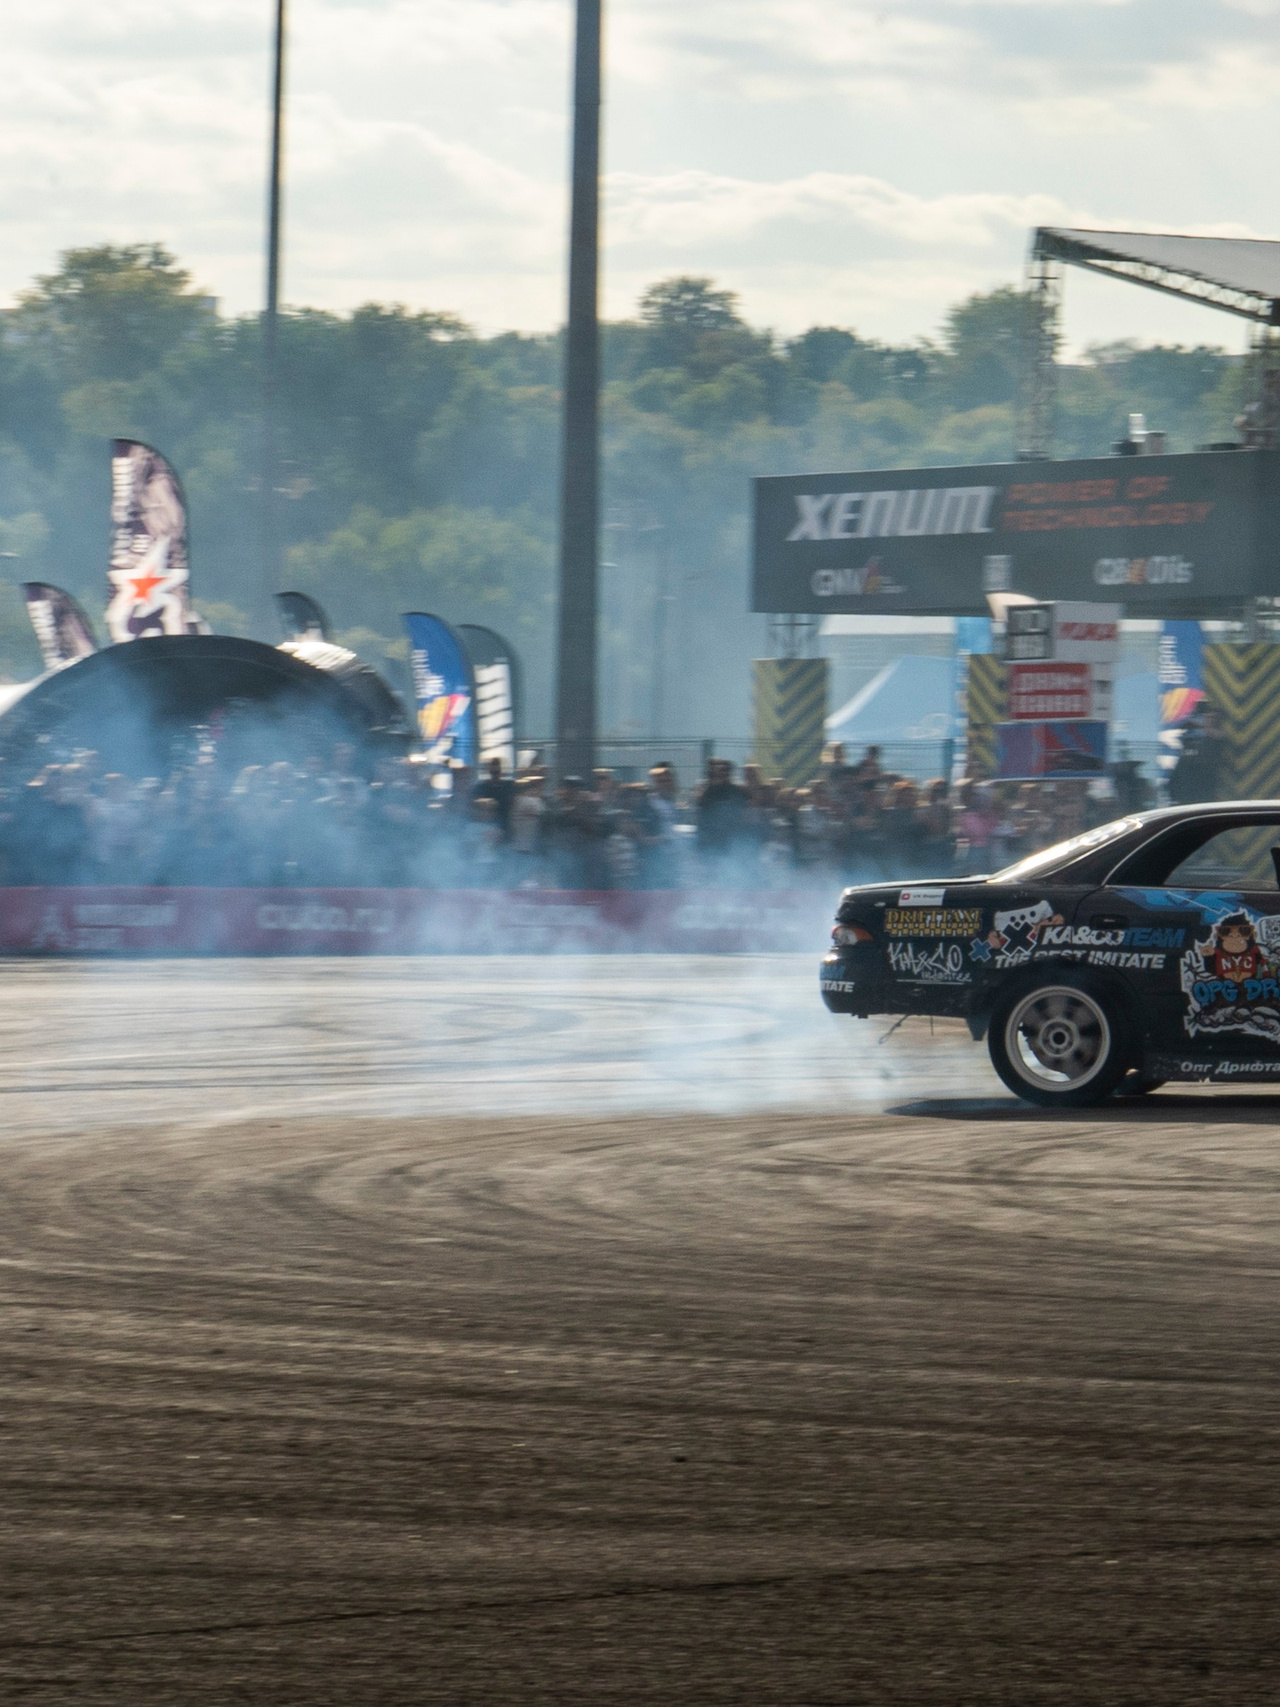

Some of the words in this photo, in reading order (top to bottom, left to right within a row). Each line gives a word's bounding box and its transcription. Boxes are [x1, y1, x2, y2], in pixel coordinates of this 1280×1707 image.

[1088, 952, 1167, 970] IMITATE
[1221, 957, 1253, 971] NYC
[1181, 1061, 1212, 1073] Опг
